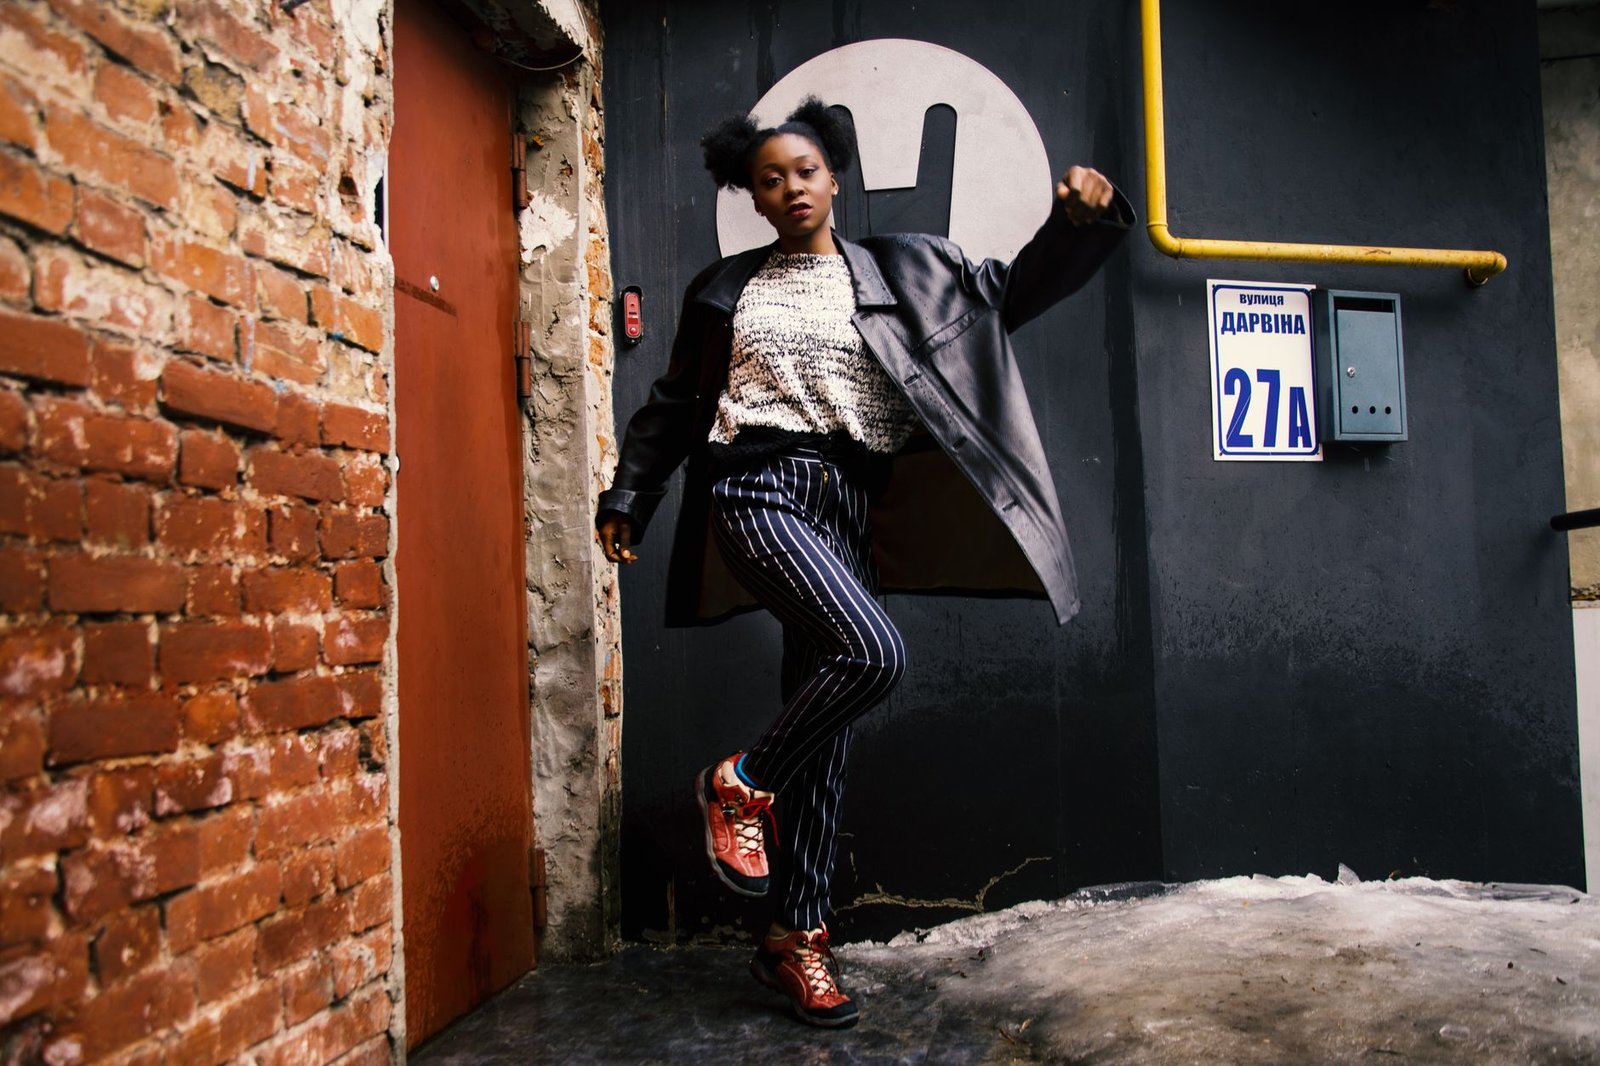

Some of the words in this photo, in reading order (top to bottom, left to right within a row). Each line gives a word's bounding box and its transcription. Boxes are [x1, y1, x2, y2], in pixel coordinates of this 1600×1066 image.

[1239, 293, 1284, 307] вулиця
[1221, 312, 1306, 335] ДАРВІНА
[1224, 367, 1312, 447] 27А
